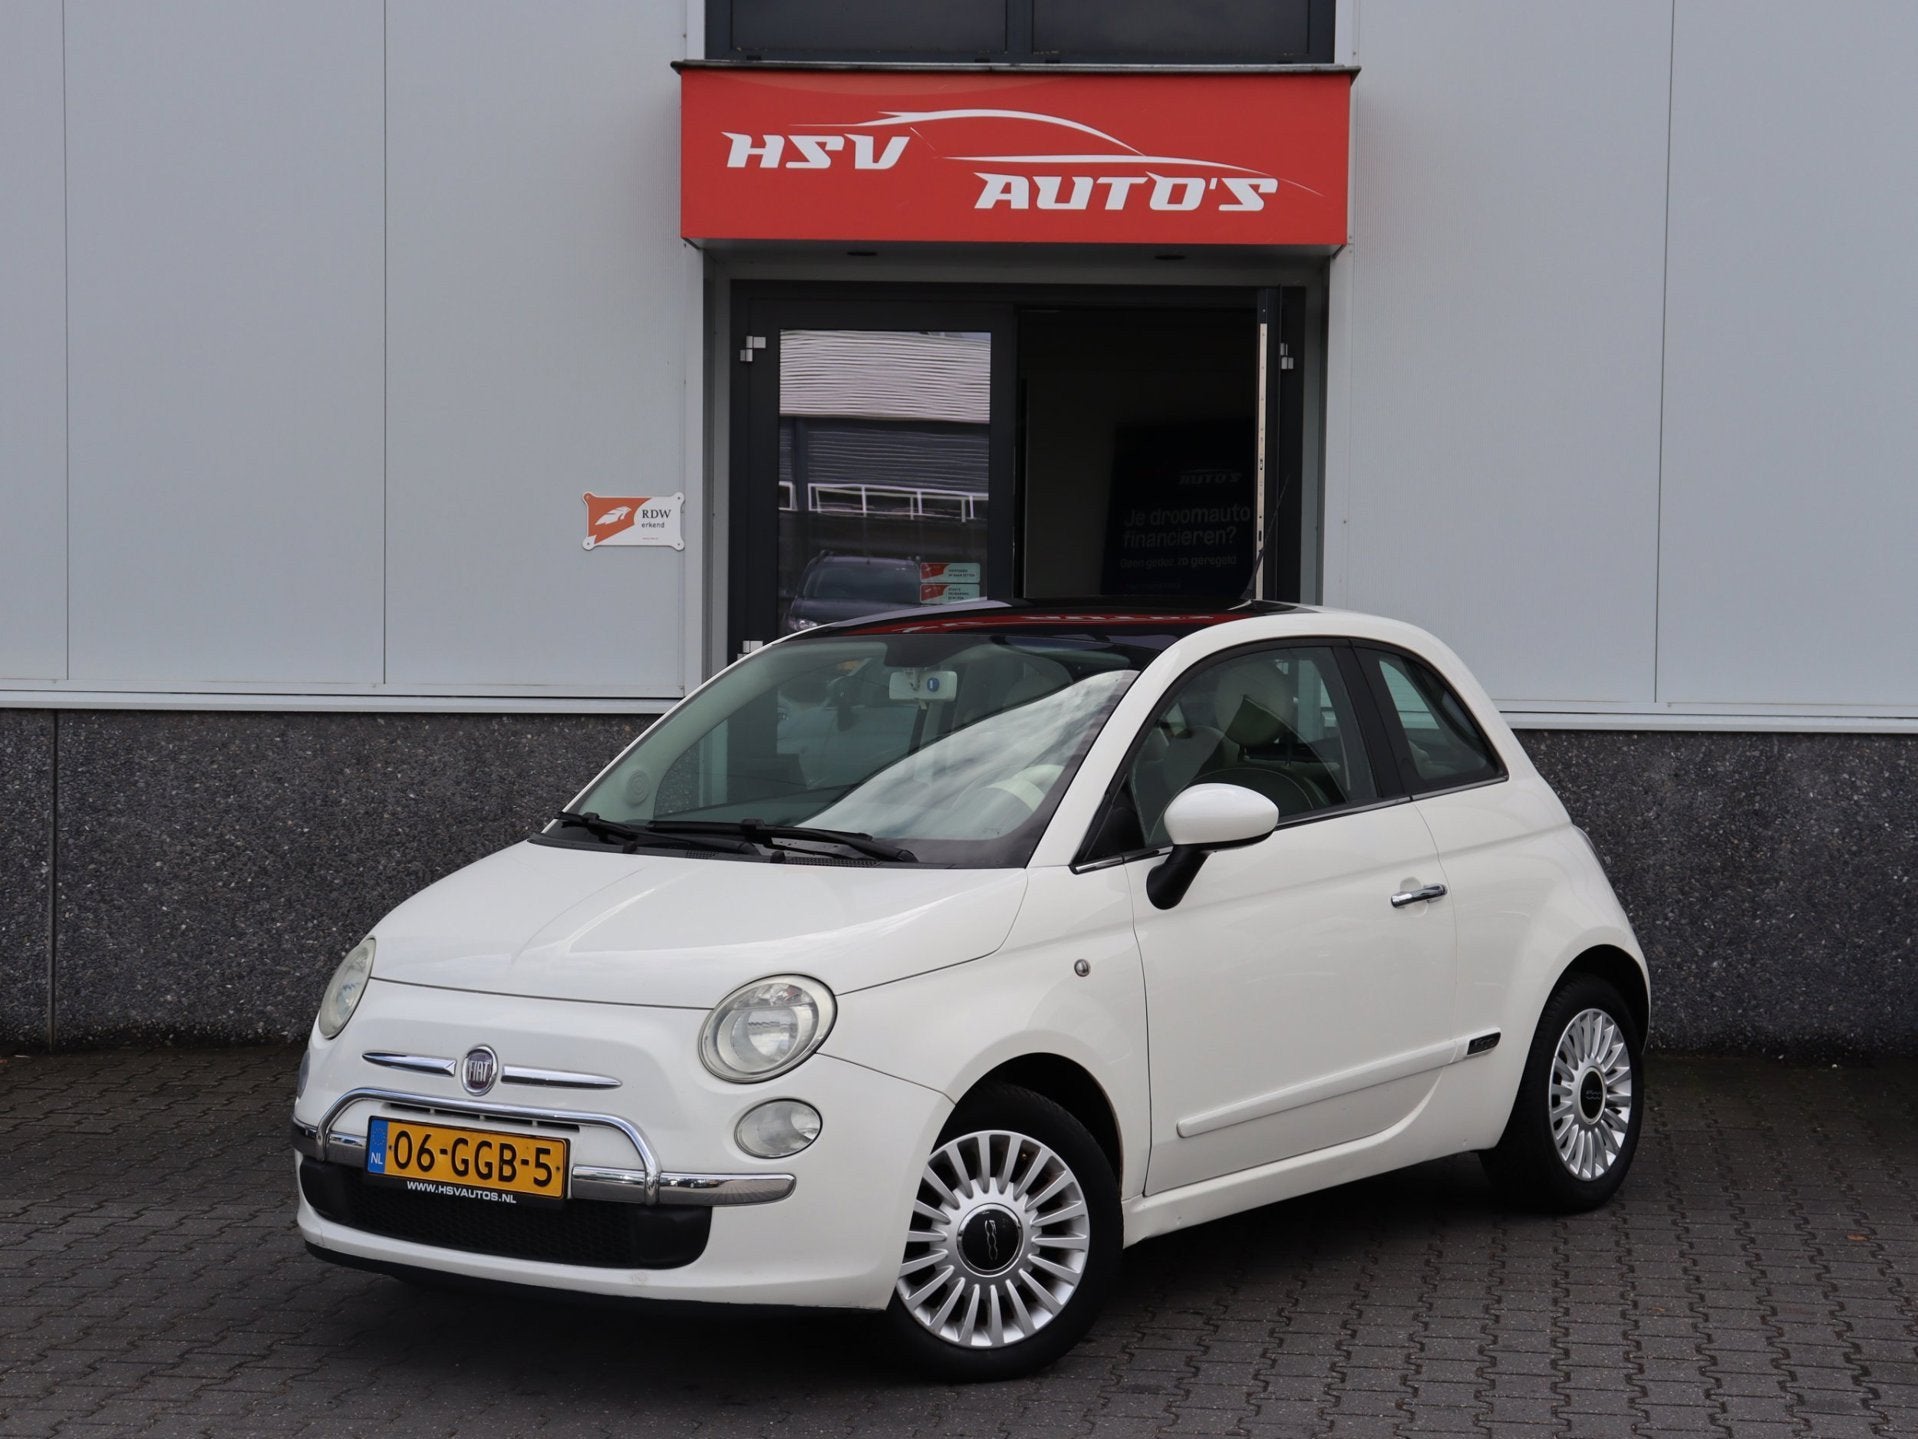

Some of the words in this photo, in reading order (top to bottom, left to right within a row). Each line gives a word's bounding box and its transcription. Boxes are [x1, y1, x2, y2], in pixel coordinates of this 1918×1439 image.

[721, 131, 910, 170] HSV
[973, 171, 1279, 212] AUTO'S
[641, 508, 672, 519] RDW
[641, 521, 665, 529] erkend
[1124, 509, 1147, 527] Je
[1150, 503, 1251, 525] droomauto
[1122, 526, 1238, 549] financieren?
[467, 1060, 492, 1083] FIAT
[370, 1151, 384, 1165] NL
[393, 1130, 552, 1187] 06-GGB-5
[406, 1180, 517, 1204] WWW.HSVAUTOS.NL
